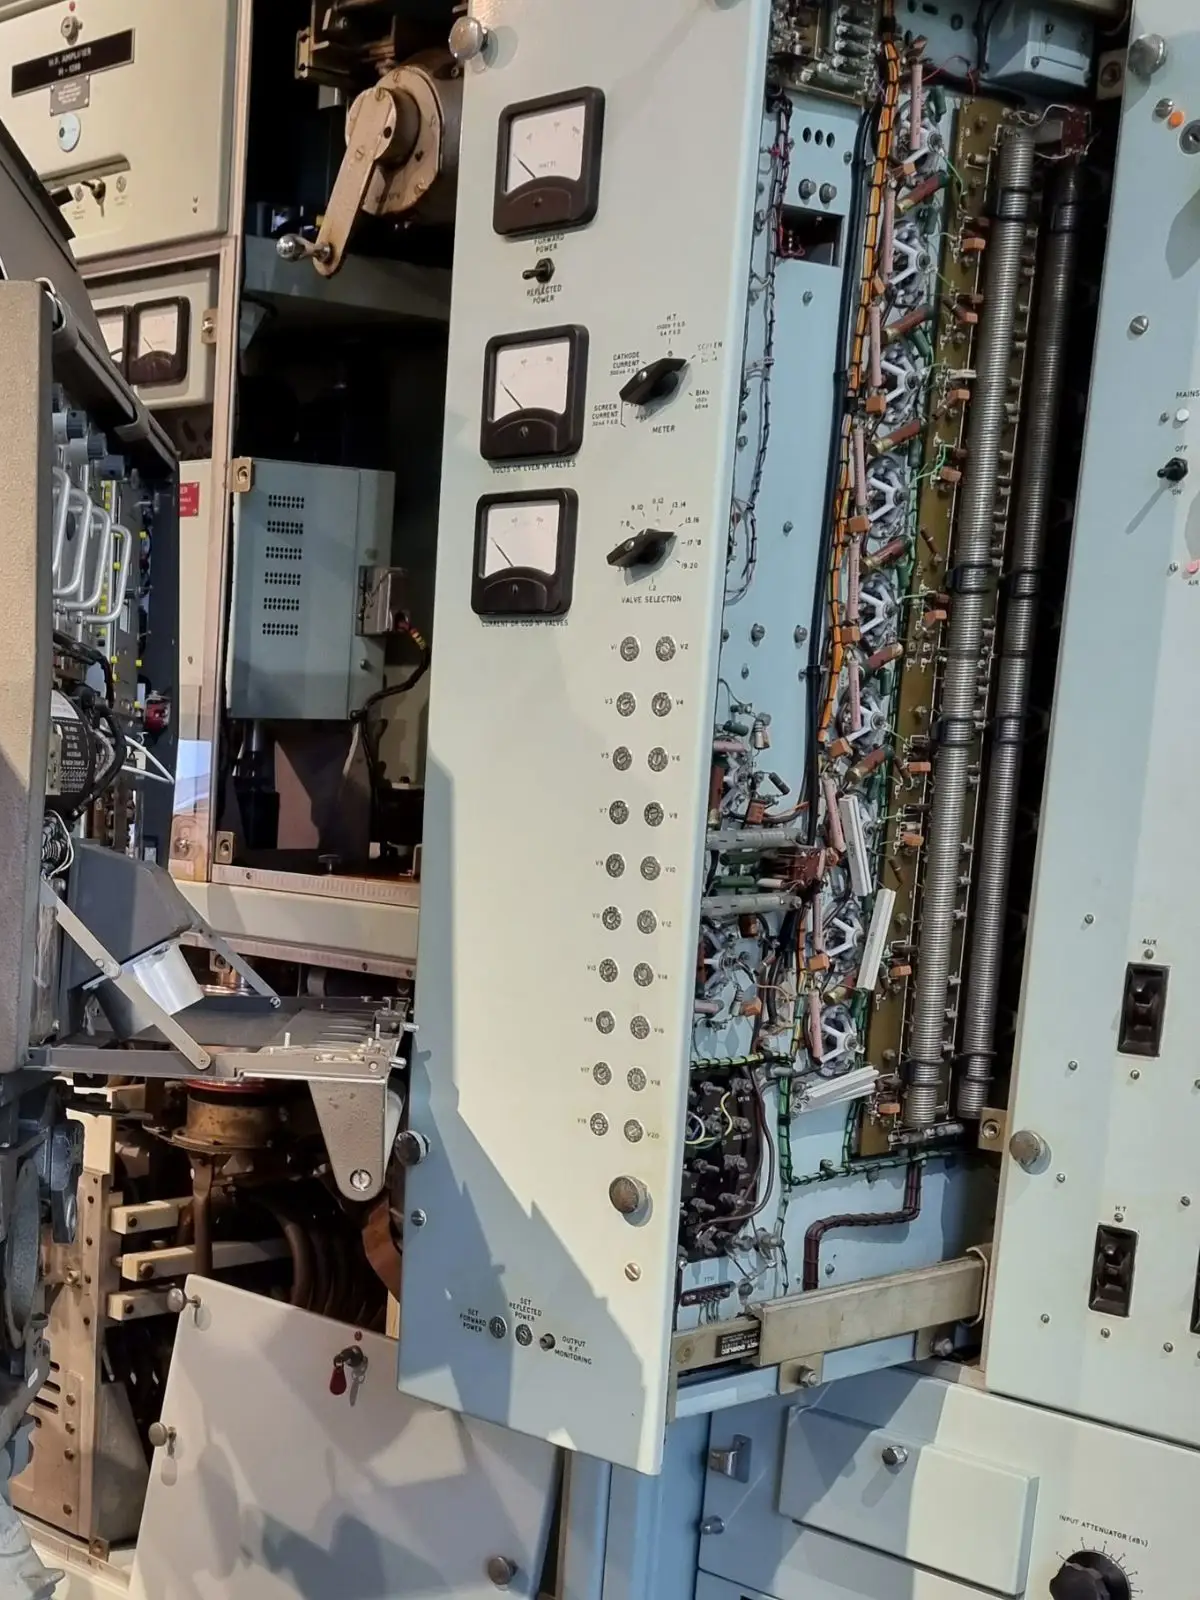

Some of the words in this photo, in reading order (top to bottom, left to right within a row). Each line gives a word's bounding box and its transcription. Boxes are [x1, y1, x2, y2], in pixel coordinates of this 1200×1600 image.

[534, 232, 565, 245] FORWARD
[535, 243, 558, 253] POWER
[527, 284, 562, 296] REFLECTED
[533, 294, 555, 304] POWER
[612, 351, 640, 361] CATHODE
[612, 359, 640, 369] CURRENT
[1175, 389, 1200, 399] MAINS
[593, 403, 618, 411] SCREEN
[591, 410, 619, 420] CURRENT
[652, 424, 676, 434] METER
[1174, 444, 1188, 452] OFF
[1171, 488, 1182, 496] ON
[621, 596, 643, 604] VALVE
[644, 595, 682, 604] SELECTION
[646, 1131, 660, 1139] V20
[519, 1297, 532, 1306] SET
[467, 1308, 479, 1317] SET
[508, 1302, 542, 1317] REFLECTED
[459, 1313, 487, 1327] FORWARD
[514, 1311, 535, 1321] POWER
[463, 1322, 483, 1333] POWER
[561, 1335, 586, 1347] OUTPUT
[554, 1349, 593, 1365] MONITORING
[1058, 1514, 1079, 1525] INPUT
[1081, 1521, 1127, 1540] ATTENUATOR
